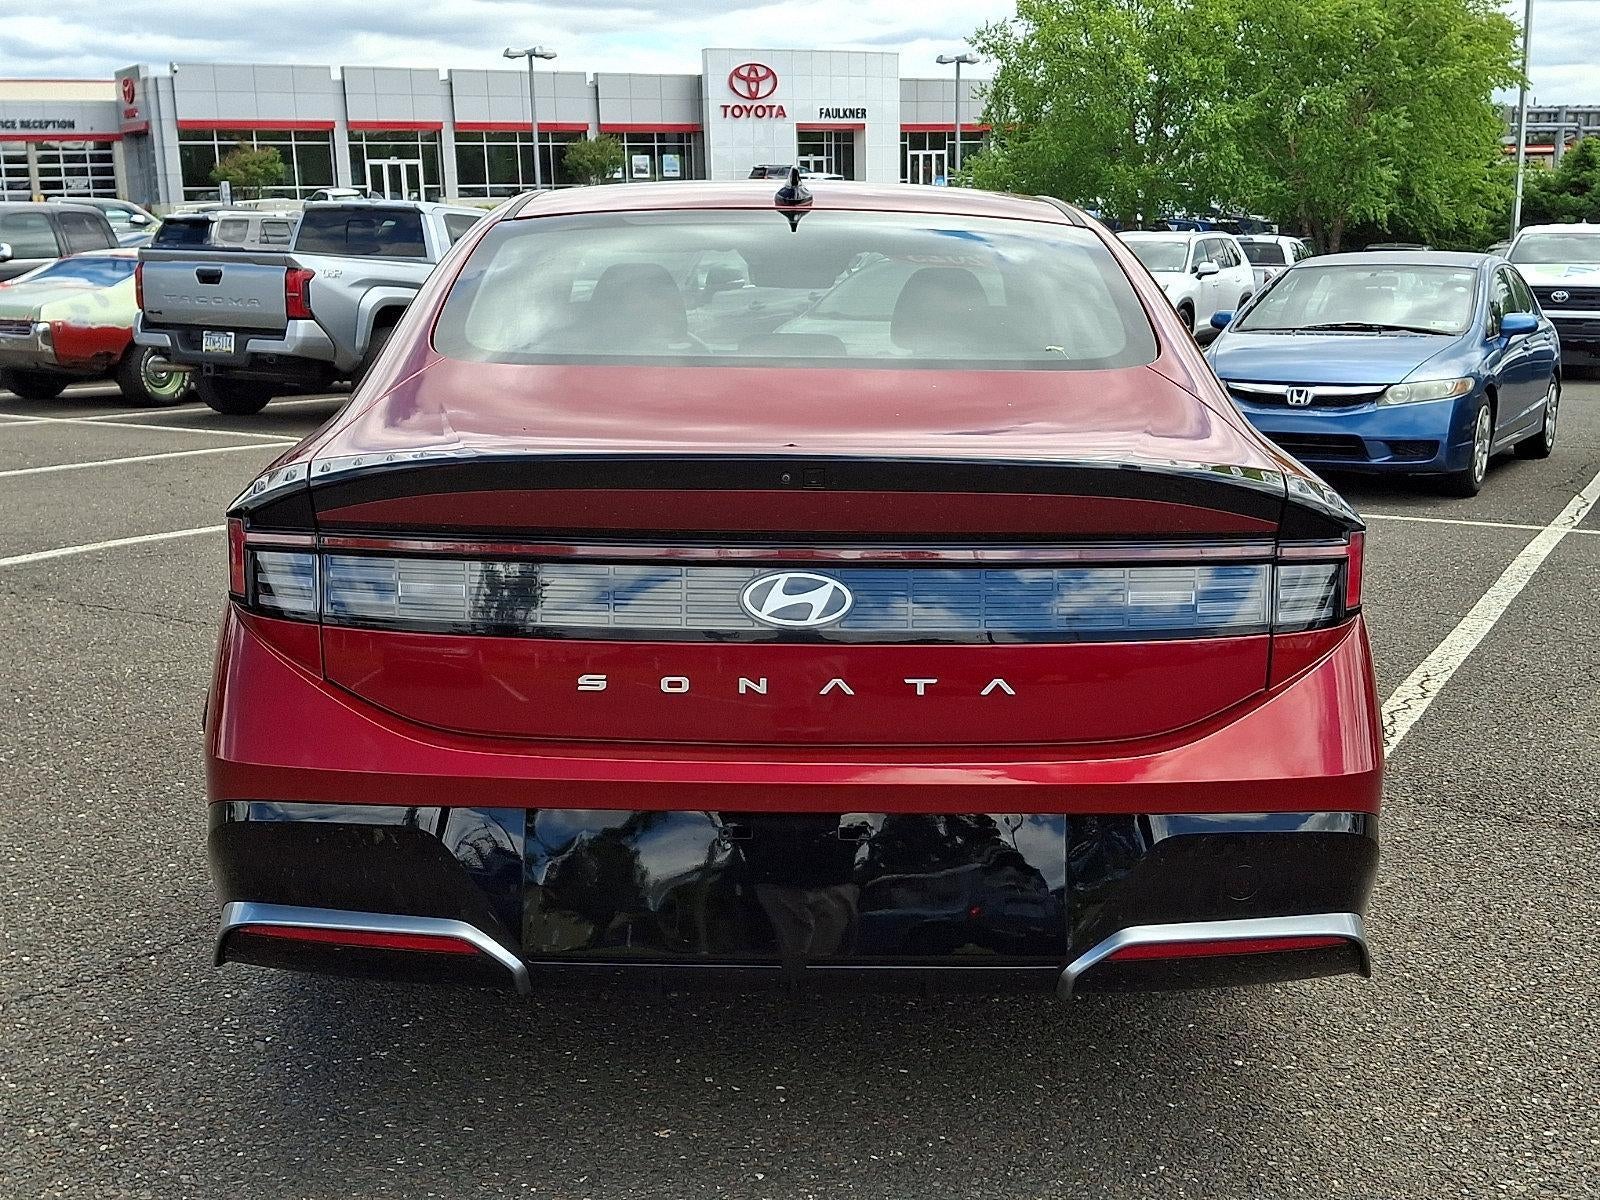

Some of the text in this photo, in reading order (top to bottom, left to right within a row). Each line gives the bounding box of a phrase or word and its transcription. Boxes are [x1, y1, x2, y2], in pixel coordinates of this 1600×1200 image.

[720, 104, 787, 119] TOYOTA
[819, 107, 867, 119] FAULKNER
[19, 119, 75, 130] RECEPTION
[164, 294, 261, 308] TACOMA
[577, 673, 1017, 696] SONATA
